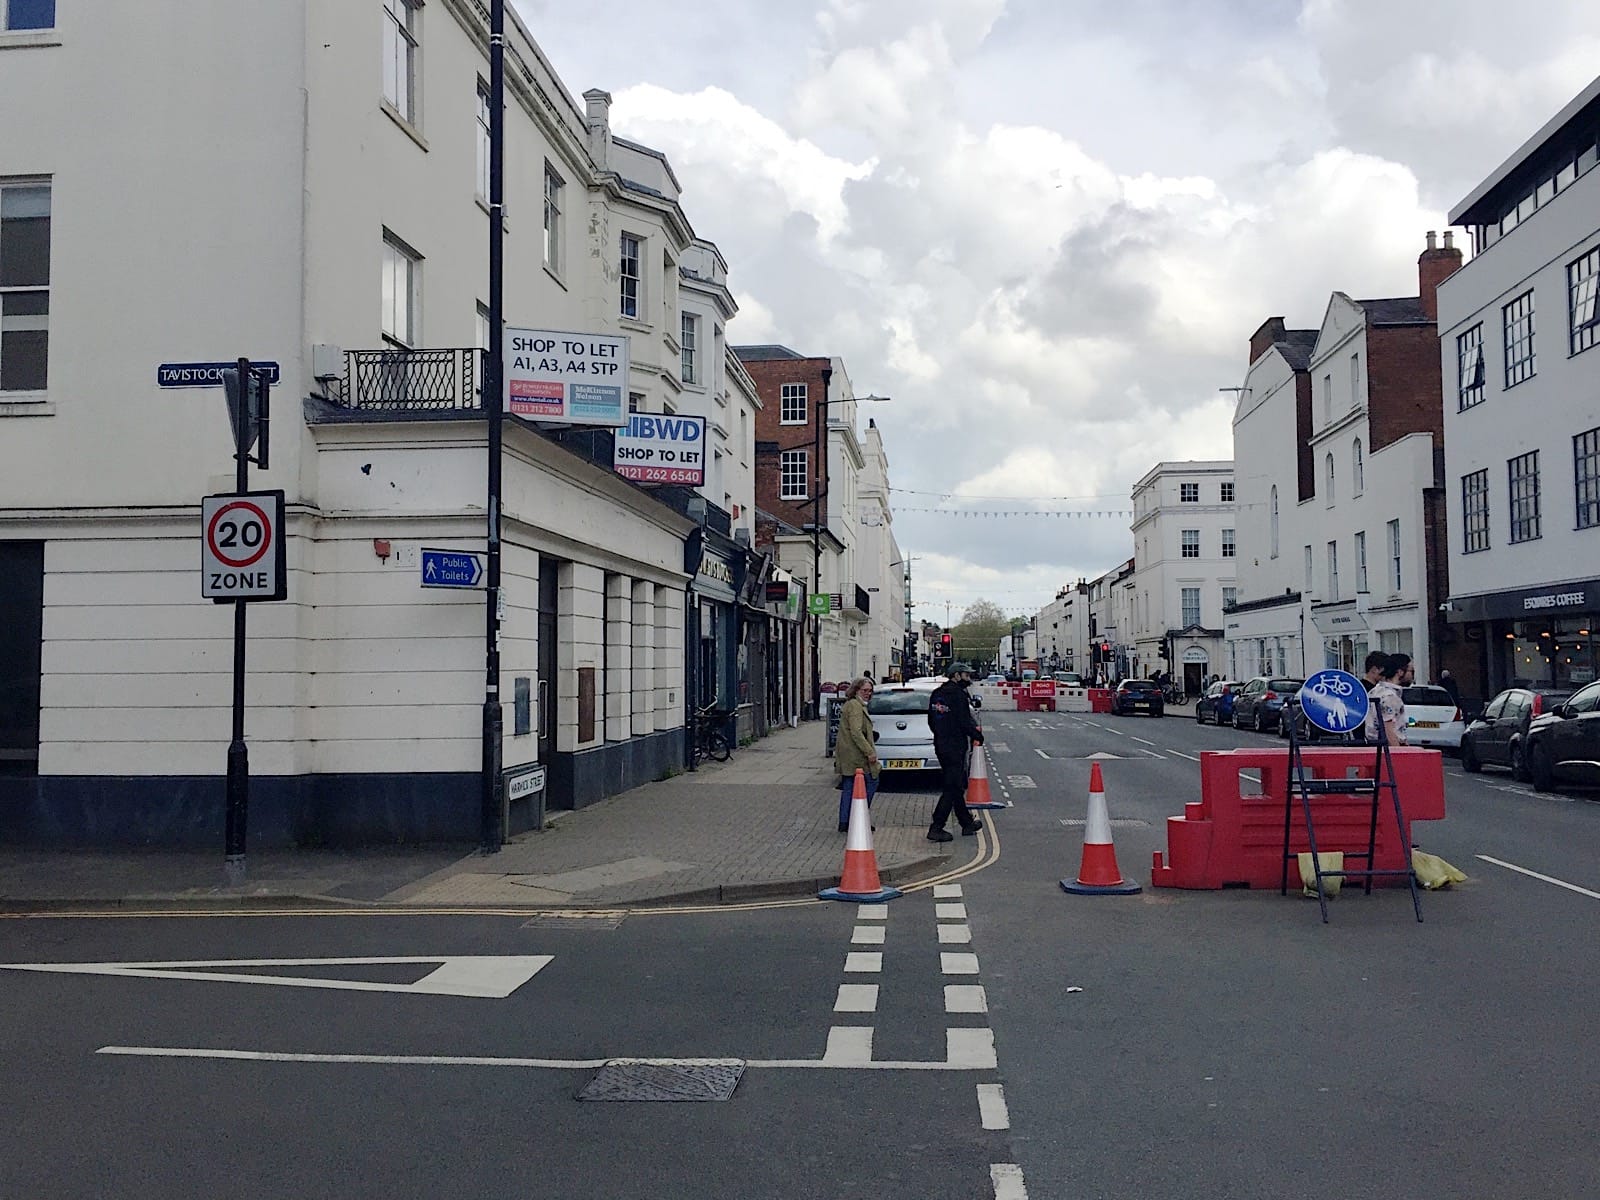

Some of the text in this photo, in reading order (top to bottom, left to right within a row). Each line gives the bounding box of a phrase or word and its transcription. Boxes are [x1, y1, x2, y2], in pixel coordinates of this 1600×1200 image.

[512, 337, 619, 358] SHOP TO LET
[513, 356, 618, 376] A1, A3, A4 STP
[160, 368, 224, 381] TAVISTOCK
[512, 404, 530, 413] 0121
[531, 405, 544, 414] 212
[618, 447, 699, 464] SHOP TO LET
[617, 467, 699, 482] 0121 262 6540
[218, 520, 262, 548] 20
[442, 557, 468, 568] Public
[210, 572, 268, 590] ZONE
[441, 570, 470, 580] Toilets
[1556, 592, 1585, 606] COFFEE
